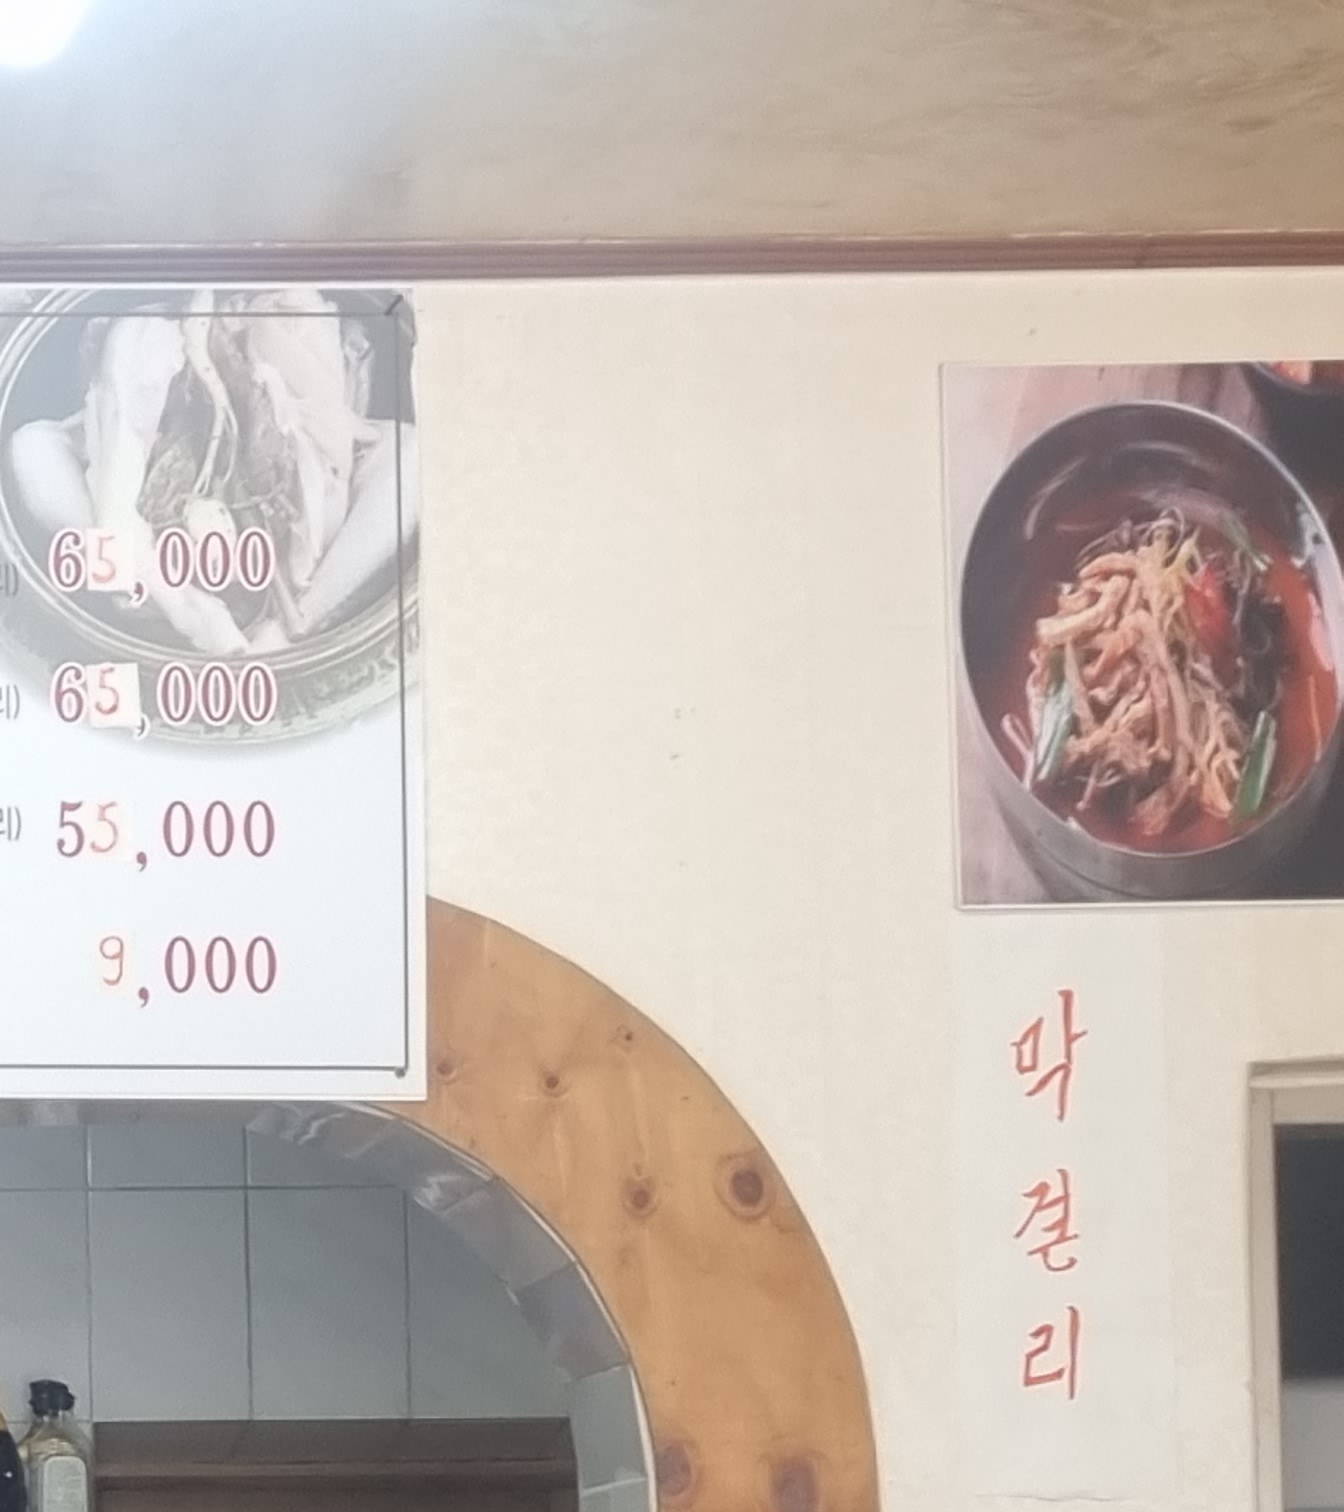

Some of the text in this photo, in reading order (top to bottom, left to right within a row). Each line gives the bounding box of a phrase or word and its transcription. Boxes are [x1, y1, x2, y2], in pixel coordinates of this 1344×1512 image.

[49, 529, 274, 603] 65,000
[50, 664, 276, 738] 65,000
[56, 800, 276, 871] 55,000
[98, 934, 278, 1006] 9,000
